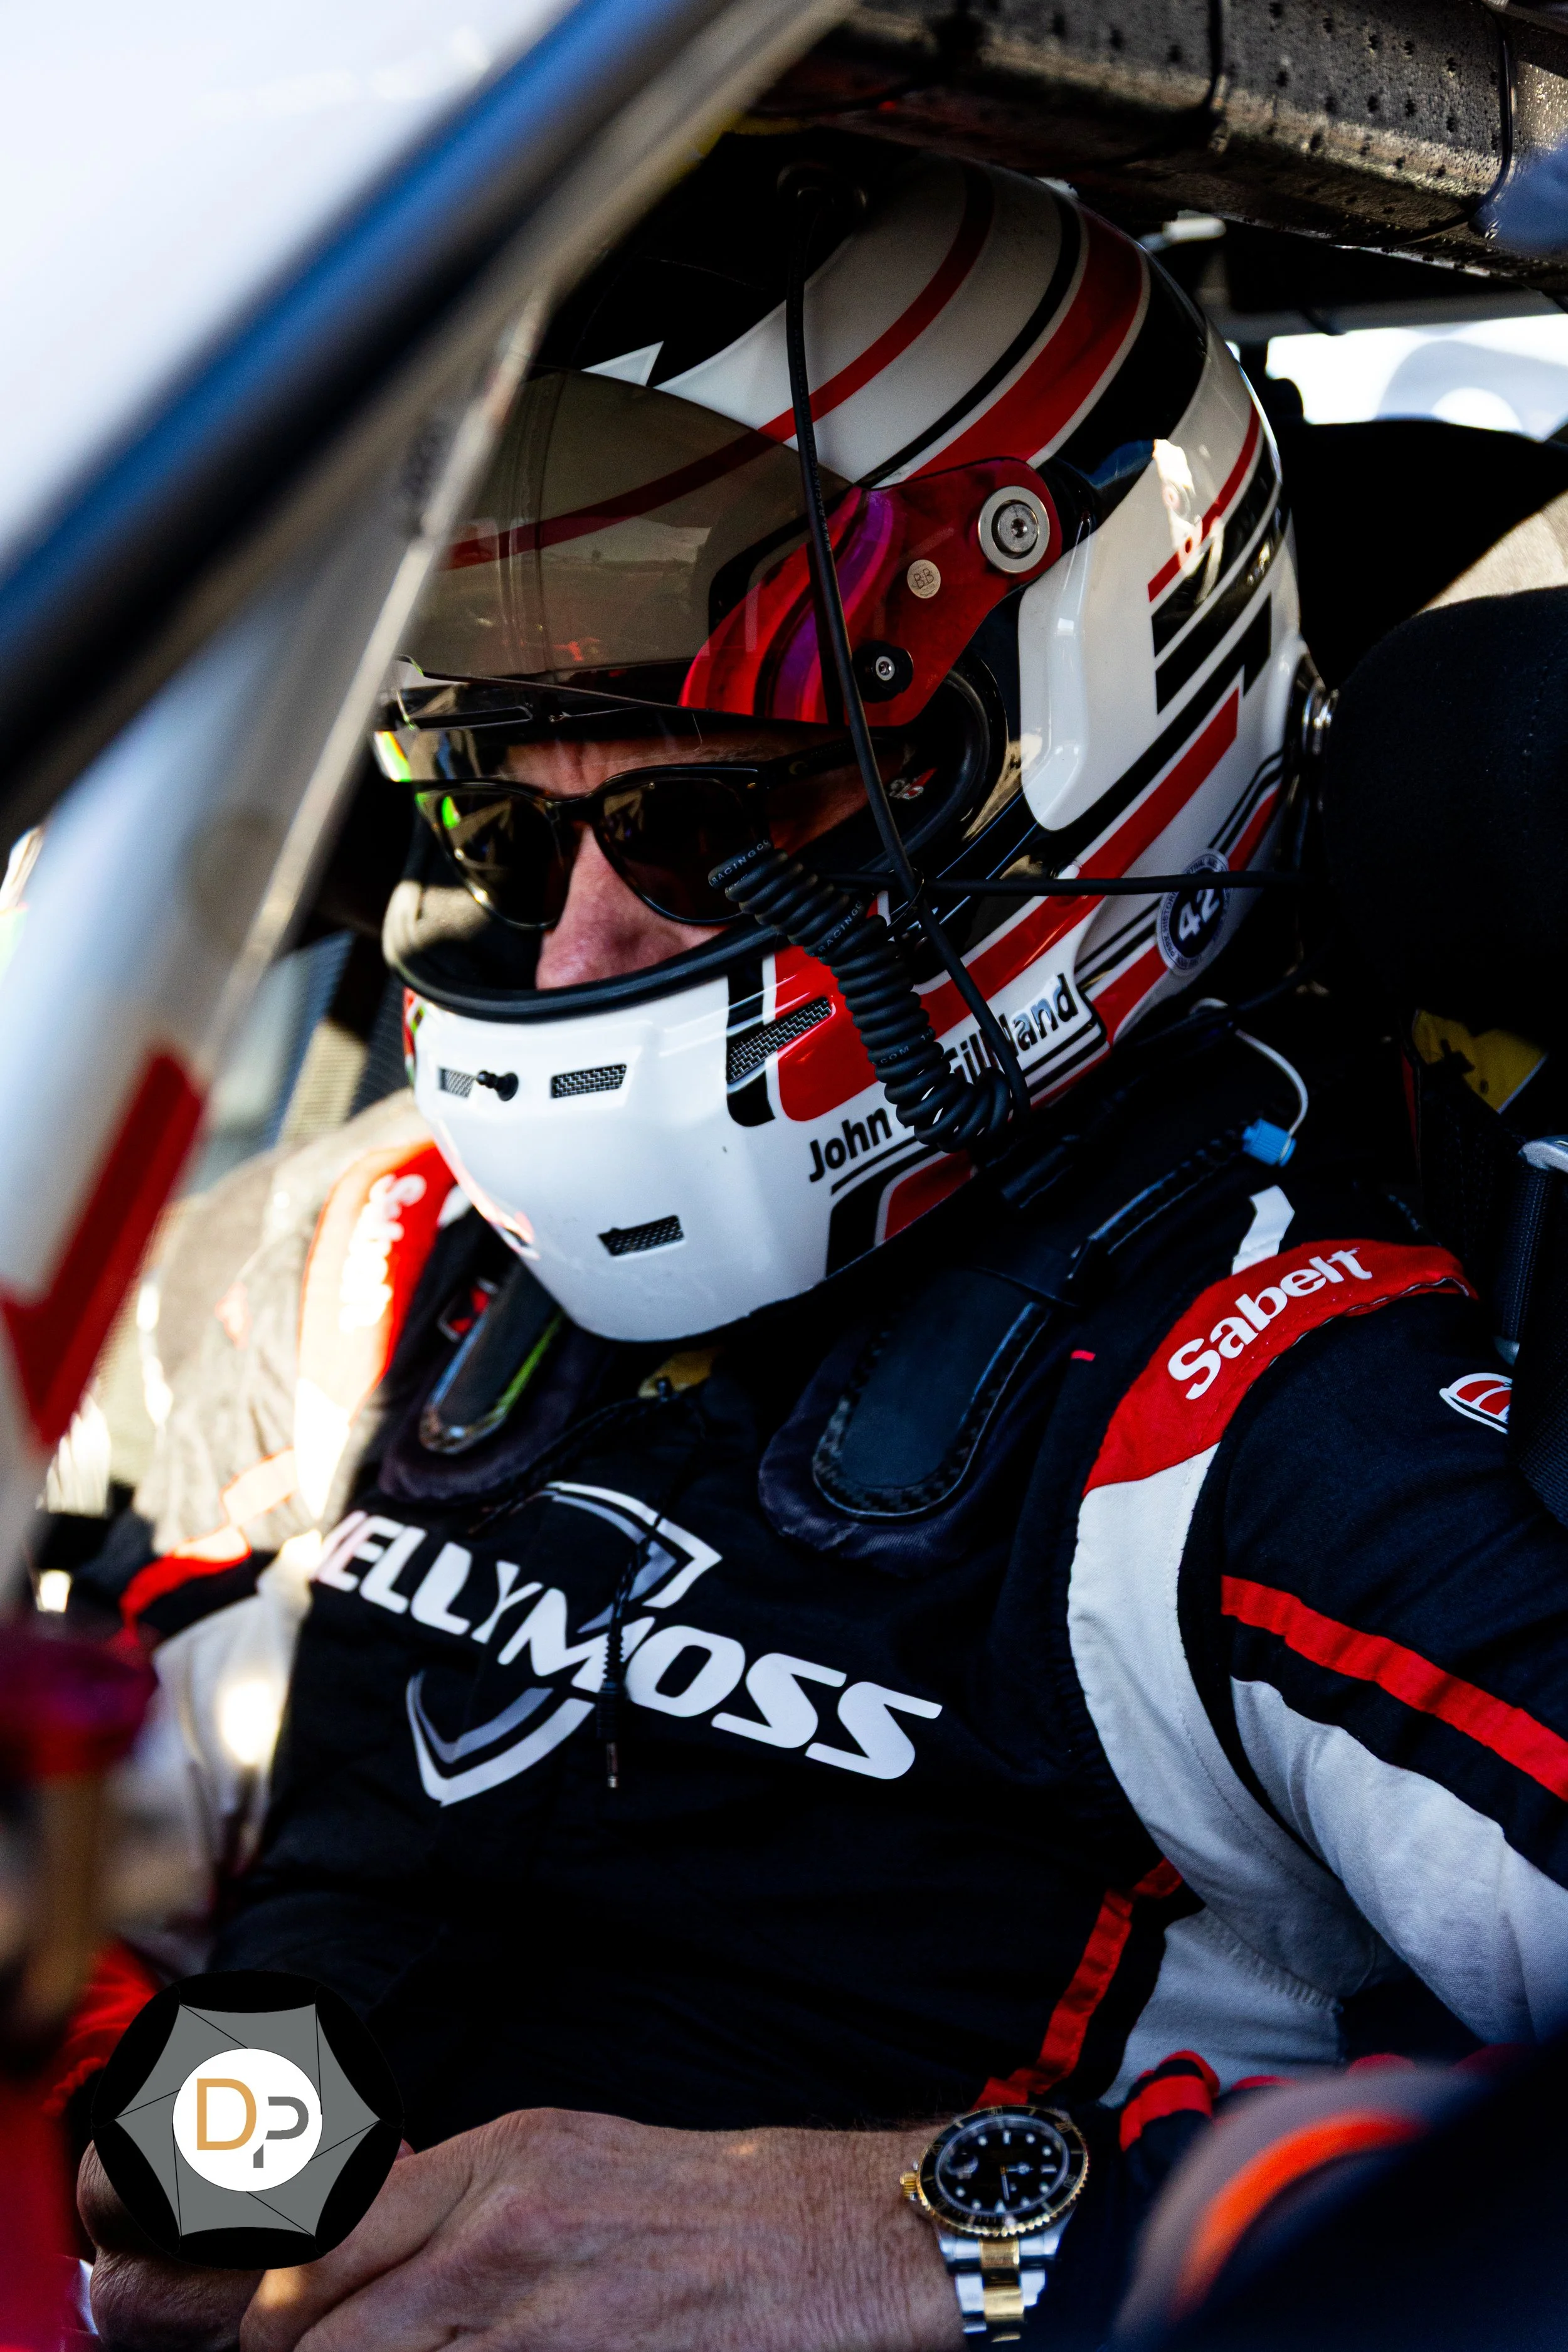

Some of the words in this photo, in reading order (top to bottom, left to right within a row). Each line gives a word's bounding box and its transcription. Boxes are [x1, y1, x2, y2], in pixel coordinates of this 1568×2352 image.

[1178, 888, 1220, 941] 42
[809, 1106, 893, 1183] John
[1167, 1247, 1373, 1401] Sabelt
